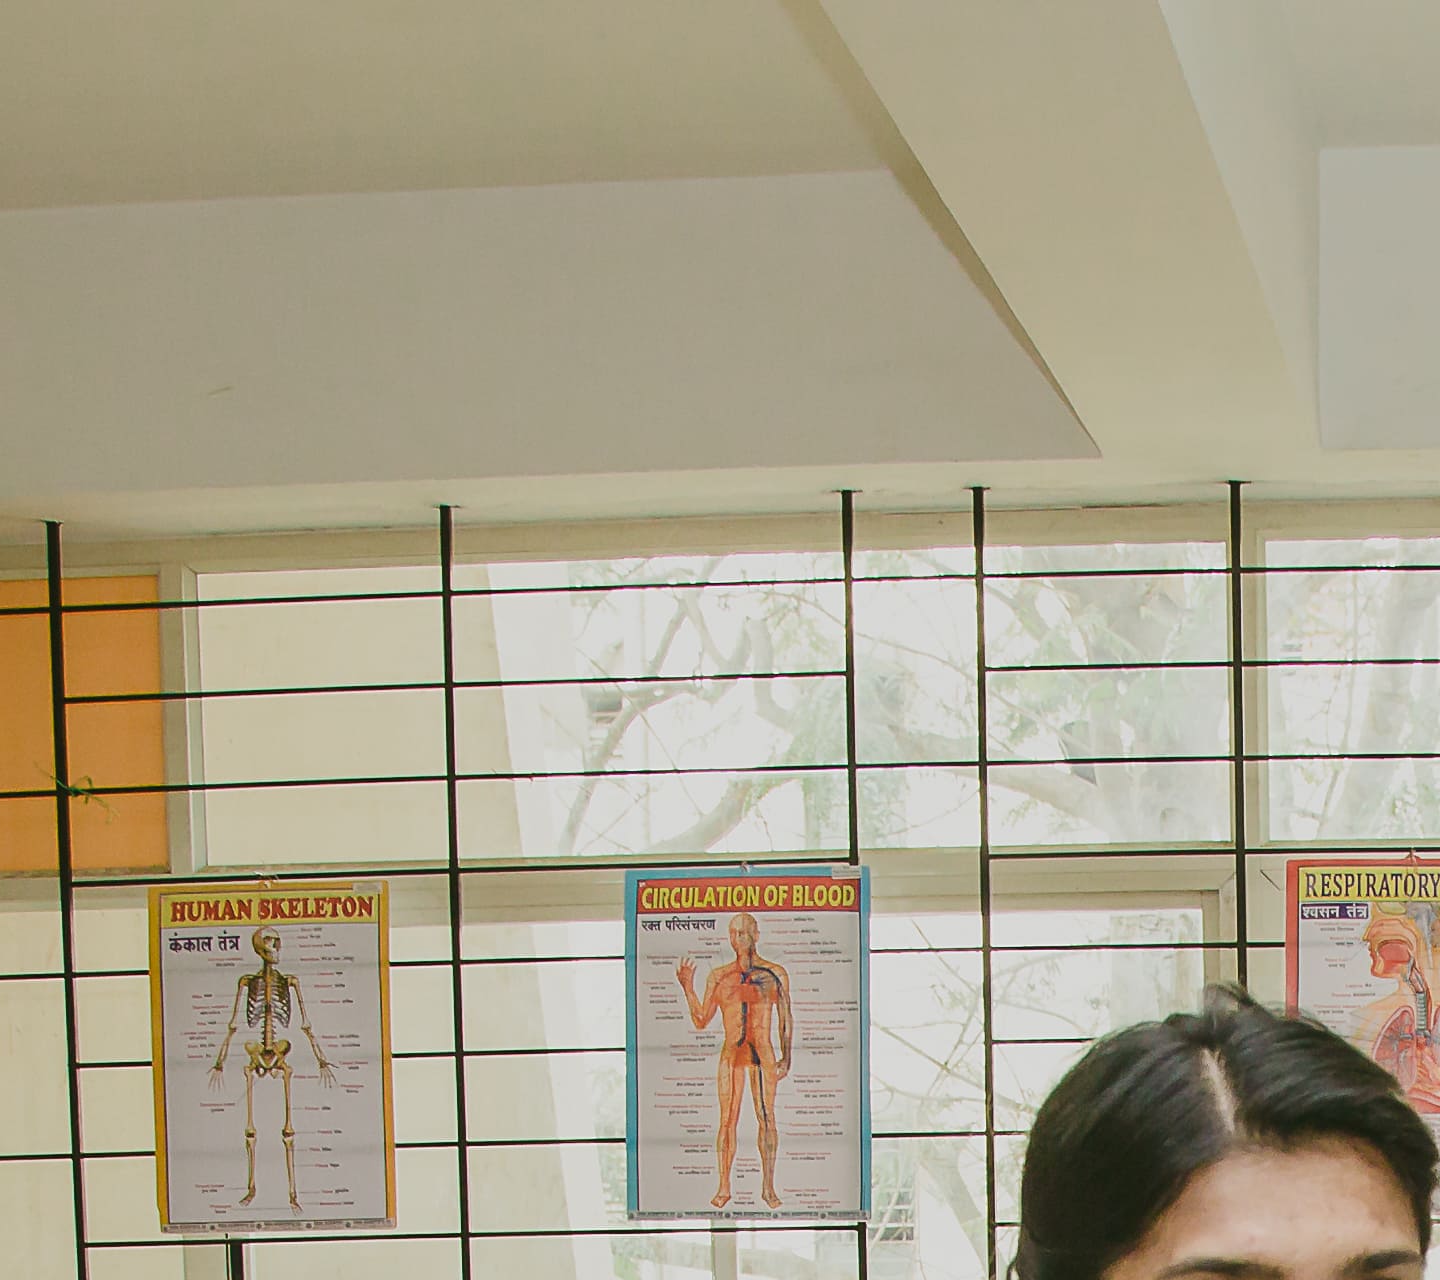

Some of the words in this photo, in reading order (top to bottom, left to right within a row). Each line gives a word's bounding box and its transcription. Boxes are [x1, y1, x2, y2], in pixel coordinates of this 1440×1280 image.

[170, 899, 253, 922] HUMAN
[258, 896, 374, 919] SKELETON
[641, 886, 760, 909] CIRCULATION
[763, 886, 789, 907] OF
[792, 885, 856, 907] BLOOD
[169, 932, 213, 952] कंकाल
[218, 930, 241, 951] तंत्र
